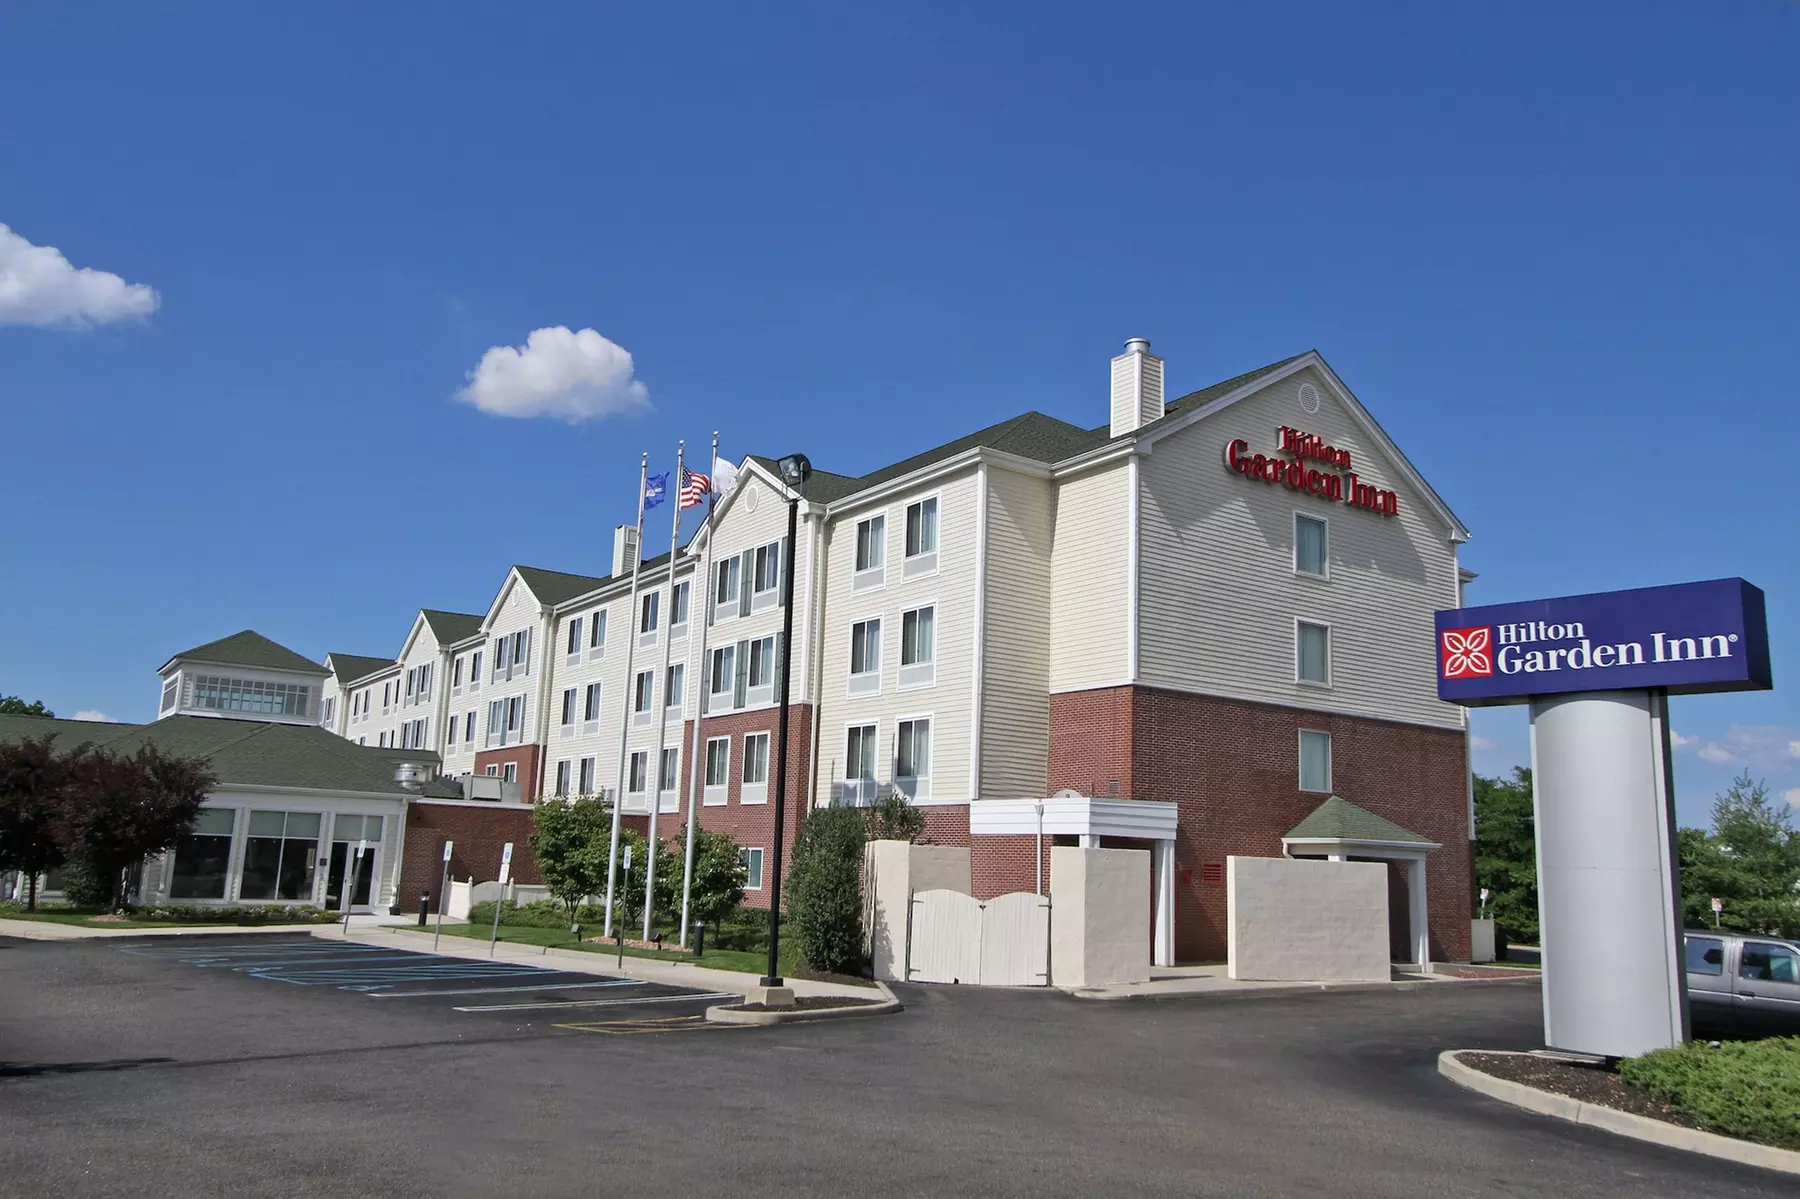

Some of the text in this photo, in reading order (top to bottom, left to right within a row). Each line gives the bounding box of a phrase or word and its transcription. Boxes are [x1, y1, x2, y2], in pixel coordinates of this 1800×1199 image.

[1278, 425, 1352, 469] Hilton
[1227, 439, 1399, 515] Garden Inn
[1498, 621, 1585, 645] Hilton
[1497, 640, 1646, 674] Garden
